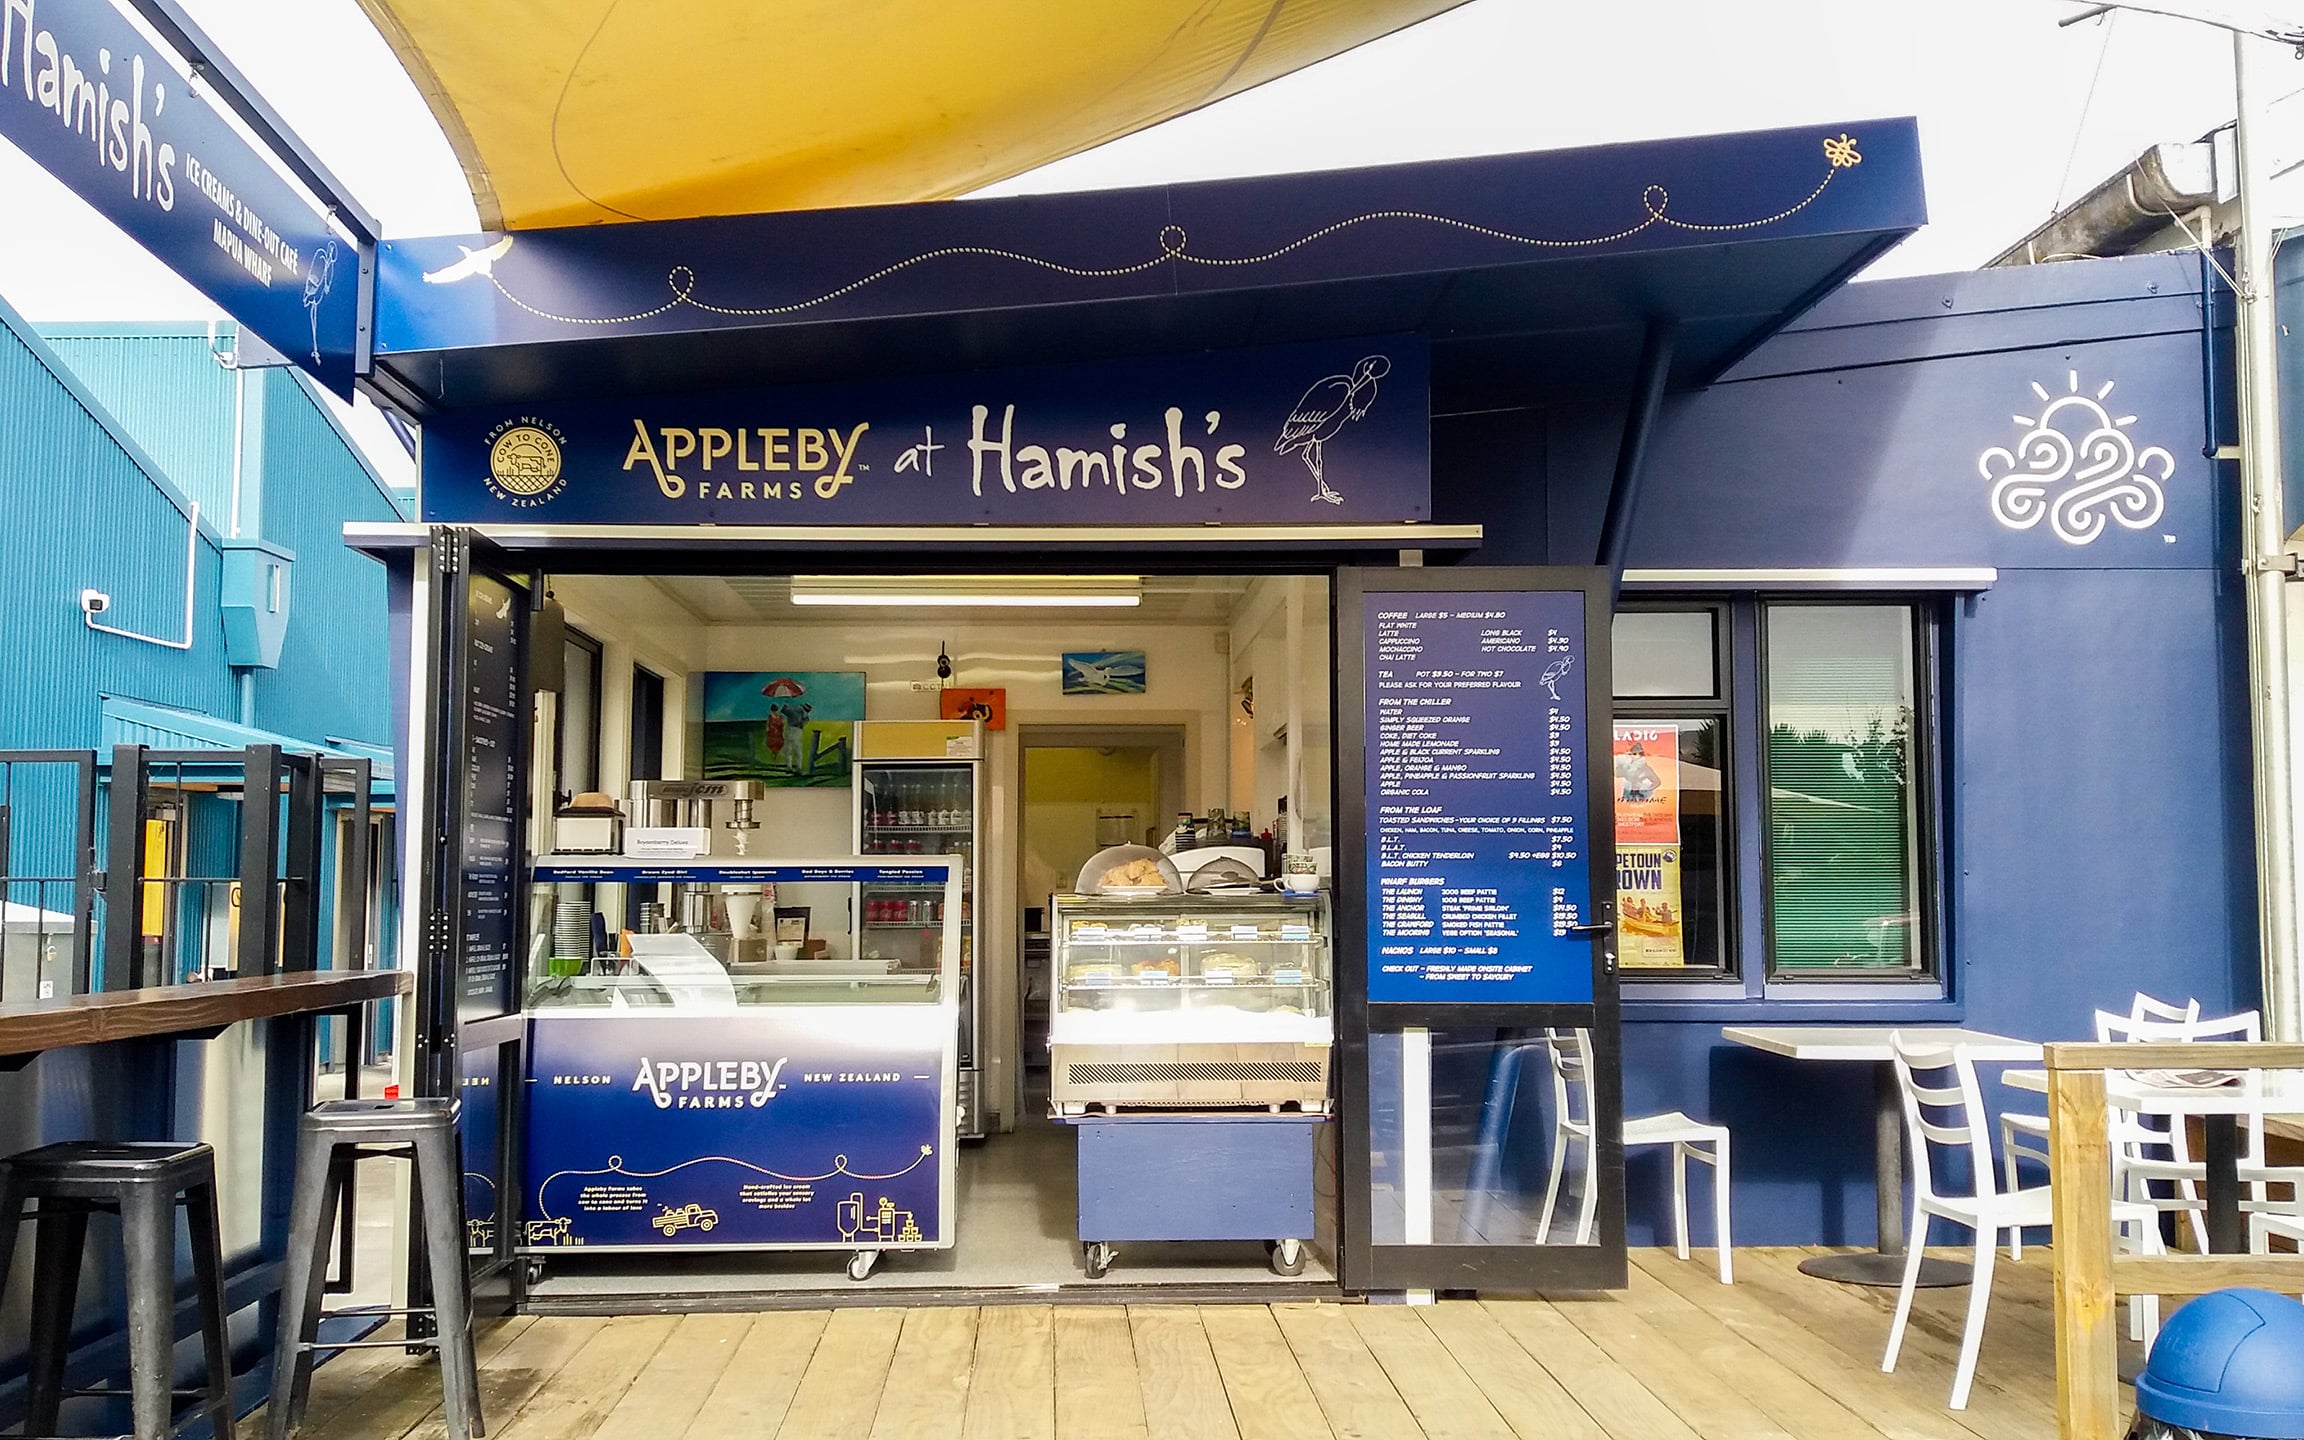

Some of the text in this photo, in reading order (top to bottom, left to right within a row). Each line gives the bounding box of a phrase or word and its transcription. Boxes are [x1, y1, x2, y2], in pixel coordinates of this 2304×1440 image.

[2, 0, 176, 211] Hamish's
[186, 153, 298, 276] ICE CREAMS & DINE-OUT CAFÉ
[213, 218, 272, 288] MAPUA WHARF
[484, 416, 567, 445] FROM NELSON
[497, 434, 554, 463] COW TO CONE
[622, 404, 1246, 499] APPLEBY at Hamish's
[484, 477, 568, 507] NEW ZEALAND
[700, 482, 802, 499] FARMS
[553, 1075, 611, 1085] NELSON
[632, 1057, 788, 1109] APPLEBY
[804, 1072, 901, 1083] NEW ZEALAND
[678, 1096, 744, 1109] FARMS
